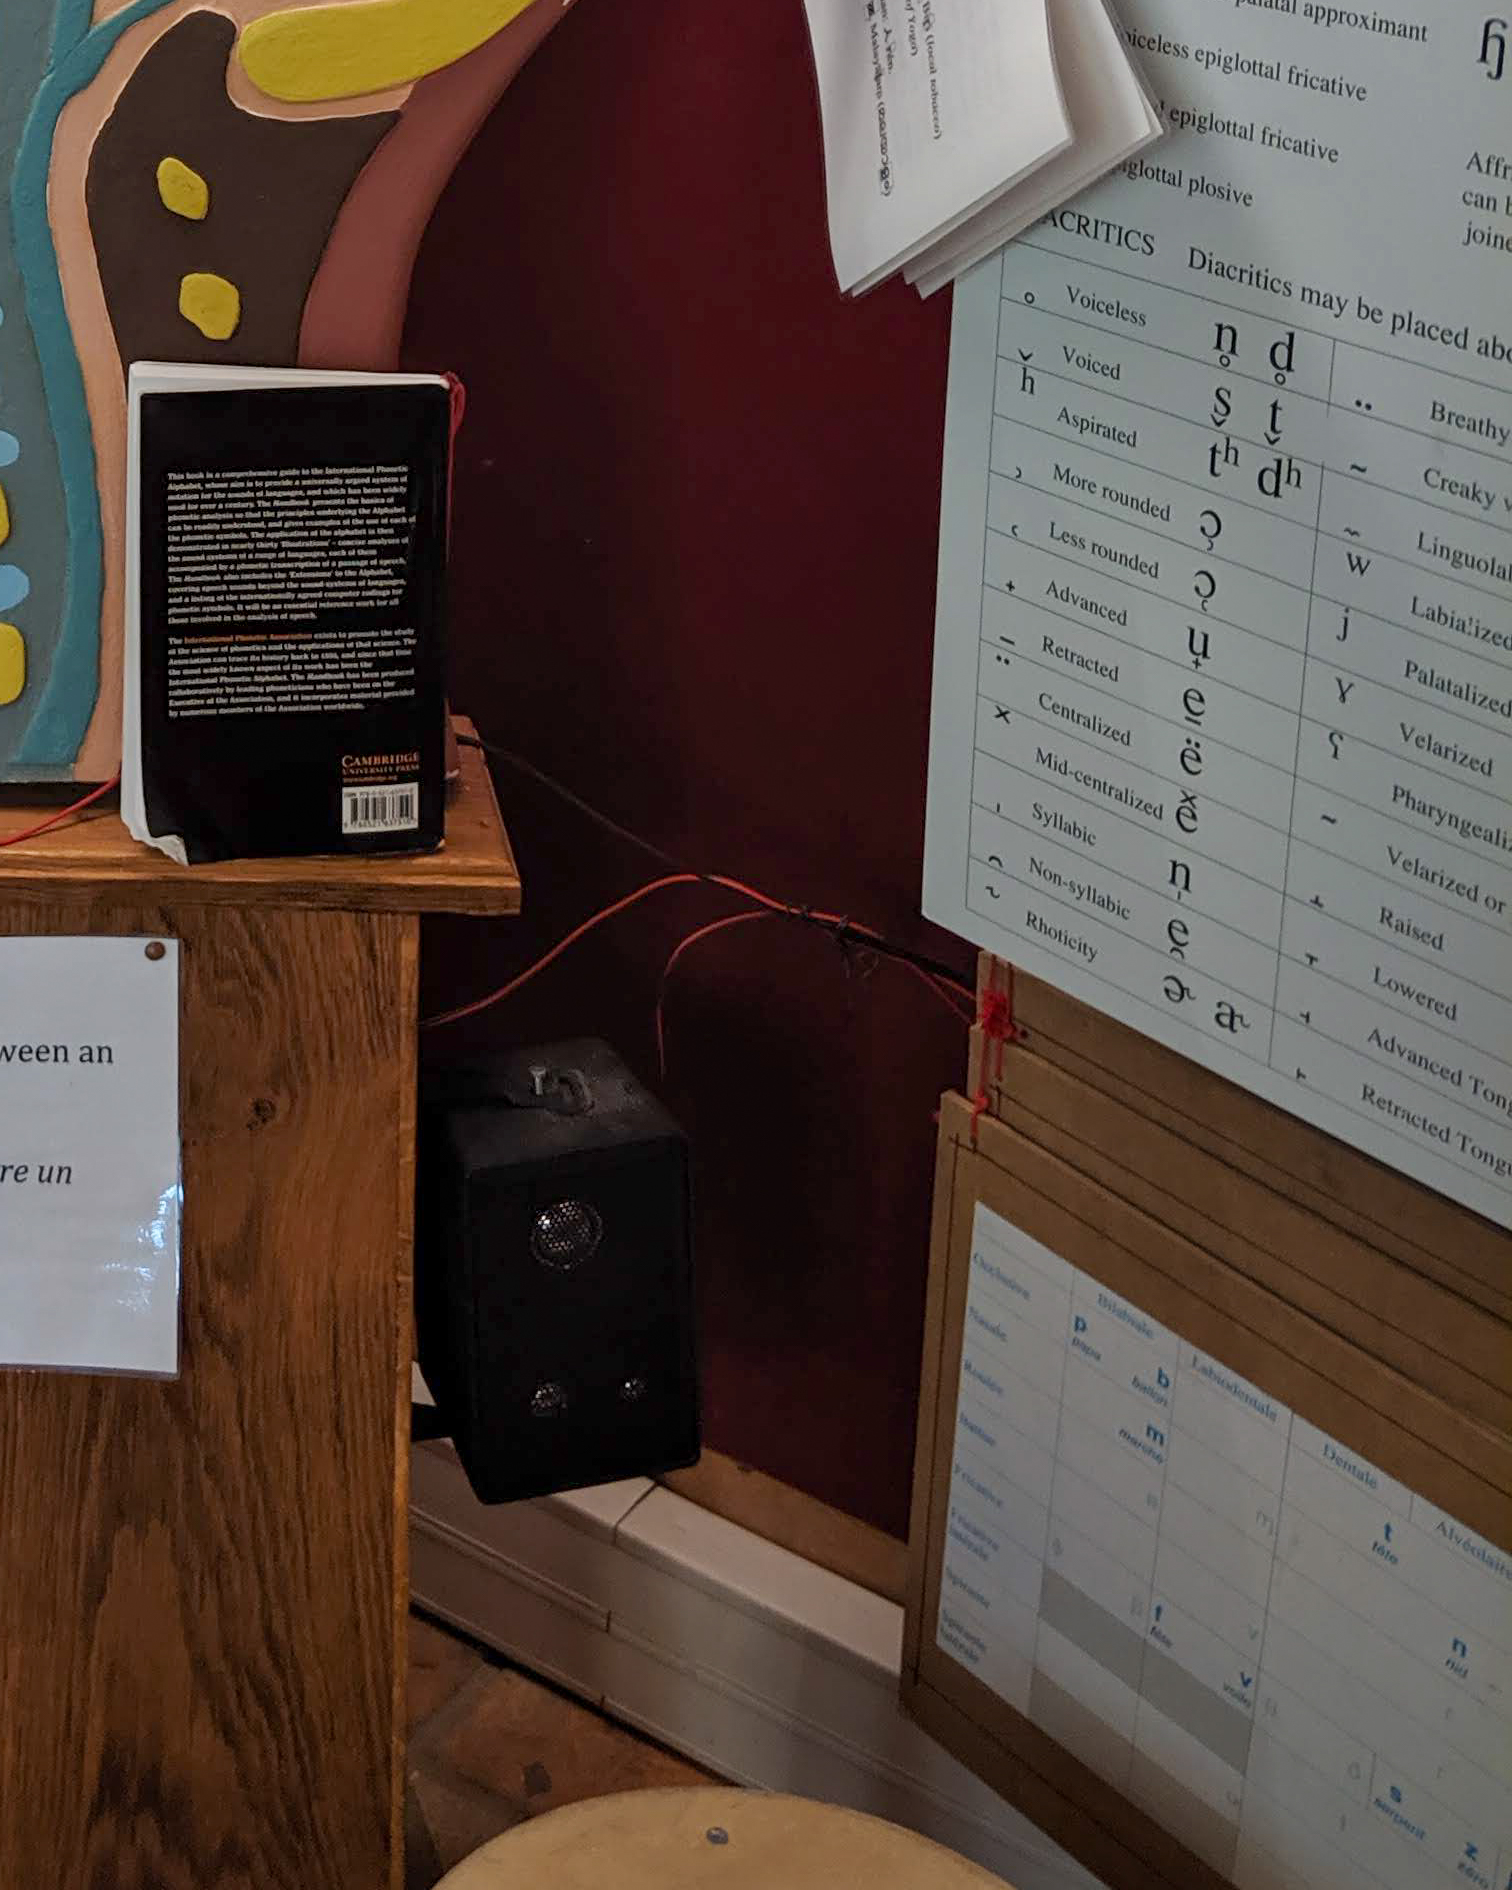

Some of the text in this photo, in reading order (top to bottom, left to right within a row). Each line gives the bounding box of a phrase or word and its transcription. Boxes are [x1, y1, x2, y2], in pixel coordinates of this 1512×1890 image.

[1304, 0, 1428, 42] approximant
[1195, 47, 1368, 102] epiglottal fricative
[1170, 107, 1338, 163] epiglottal fricative
[1189, 176, 1254, 207] plosive
[1462, 189, 1497, 213] can
[1042, 209, 1469, 350] ACRITICS Diacritics may be placed
[1066, 285, 1147, 327] Voiceless
[1063, 345, 1122, 381] Voiced
[1057, 406, 1138, 448] Aspirated
[1429, 400, 1510, 447] Breathy
[1054, 464, 1171, 522] More rounded
[1423, 466, 1496, 511] Creaky
[1049, 521, 1160, 579] Less rounded
[1046, 580, 1128, 627] Advanced
[1041, 635, 1119, 683] Retracted
[1404, 659, 1512, 718] Palatalized
[1038, 692, 1132, 747] Centralized
[342, 751, 420, 768] CAMBRIDGE
[1400, 722, 1494, 777] Velarized
[1035, 747, 1164, 821] Mid-centralized
[1032, 801, 1097, 846] Syllabic
[1029, 857, 1131, 921] Non-syllabic
[1387, 845, 1507, 914] Velarized or
[1025, 911, 1098, 964] Rhoticity
[1379, 906, 1445, 952] Raised
[1373, 966, 1457, 1022] Lowered
[78, 1042, 114, 1065] an
[1368, 1026, 1463, 1087] Advanced
[1361, 1083, 1450, 1144] Retracted
[37, 1162, 74, 1186] un
